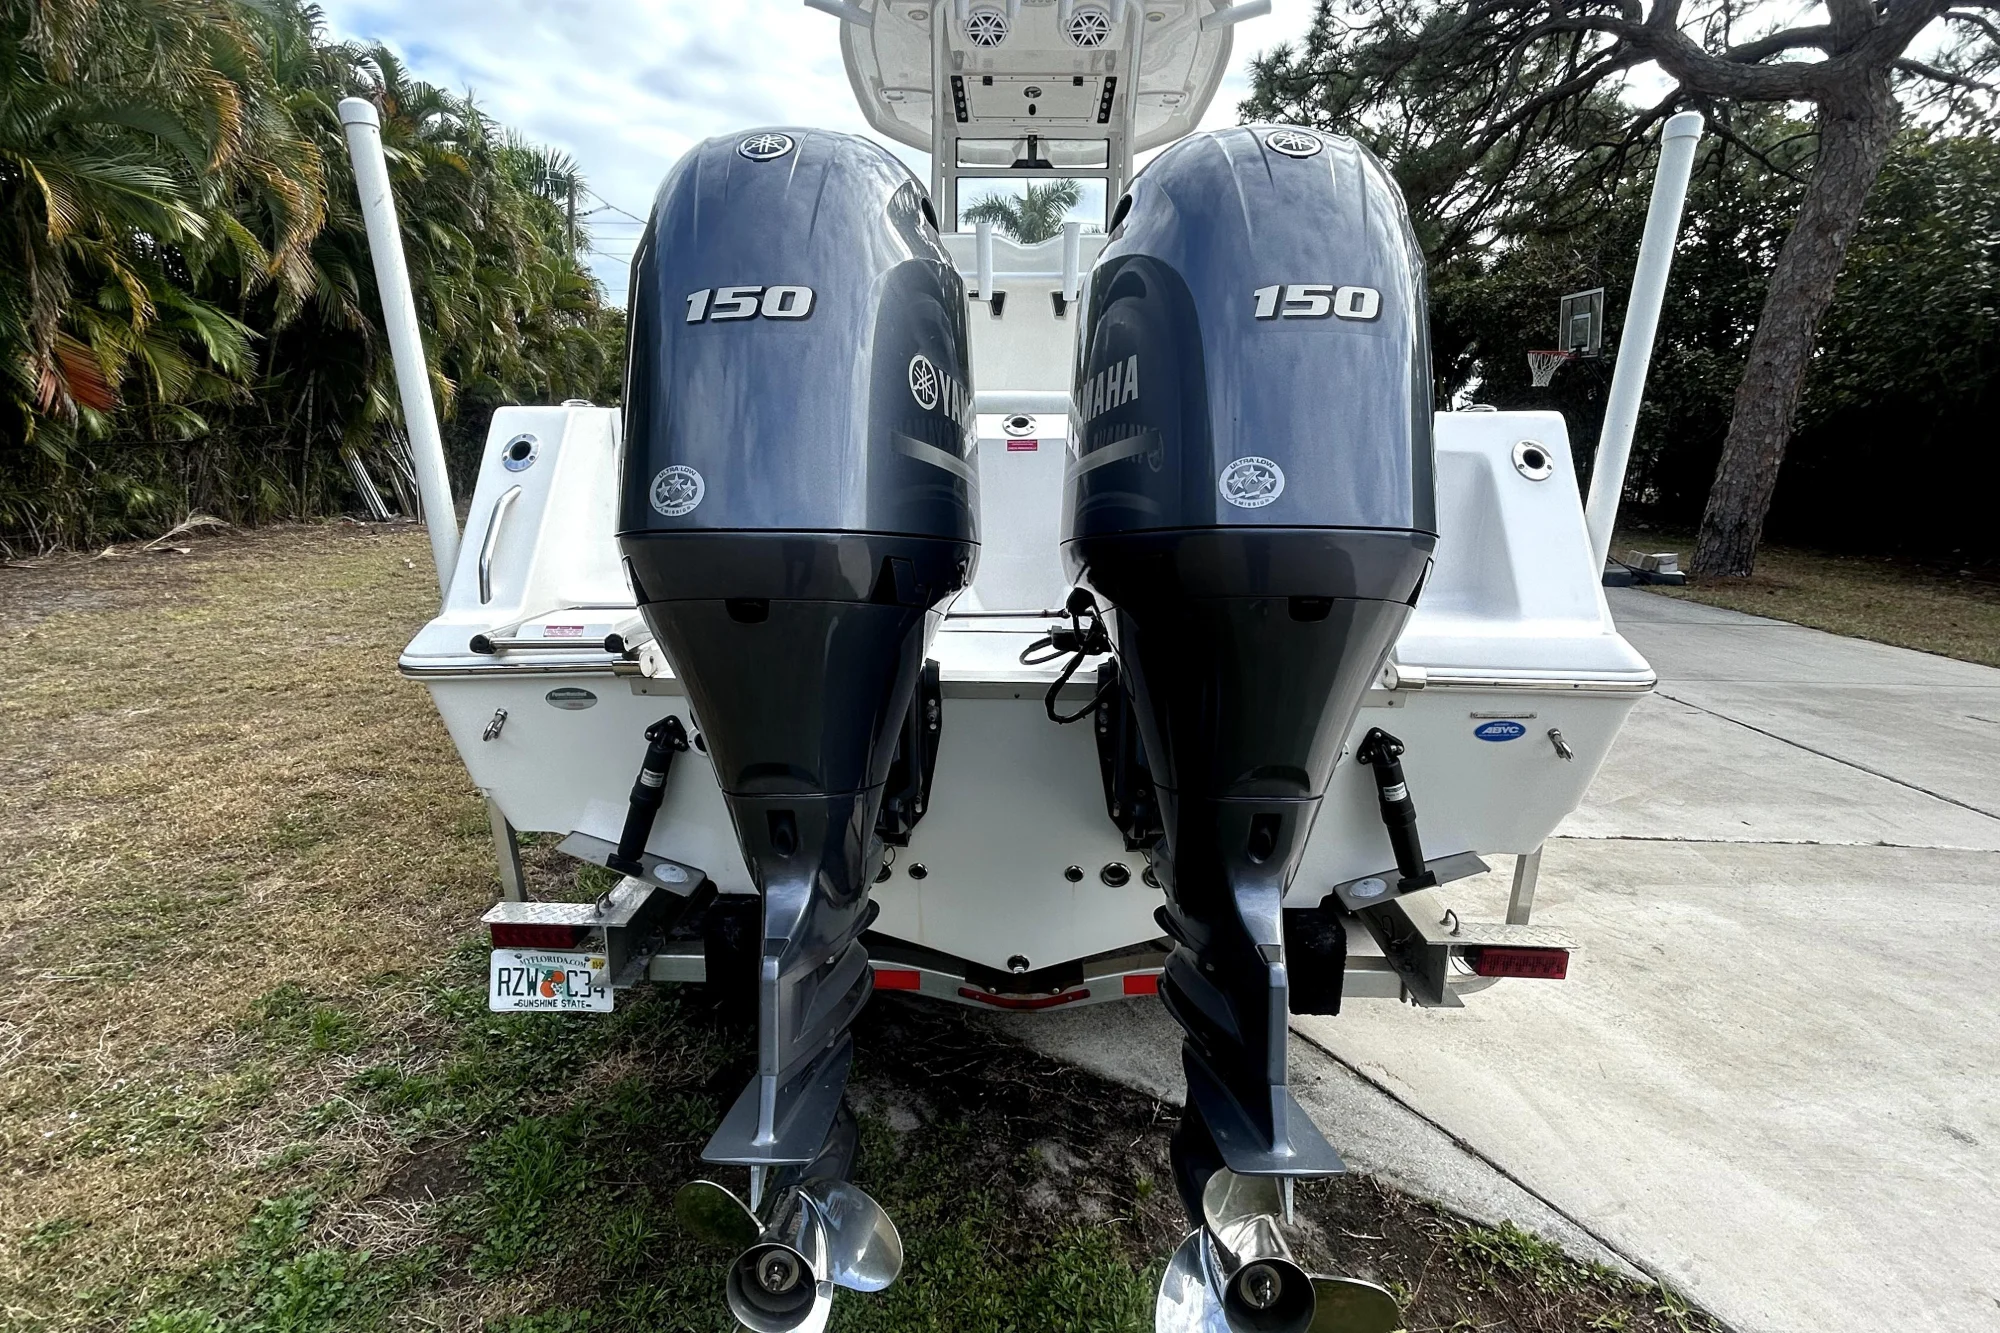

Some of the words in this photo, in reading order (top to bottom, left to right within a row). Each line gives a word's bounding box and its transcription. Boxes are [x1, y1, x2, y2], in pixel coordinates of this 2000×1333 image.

[686, 285, 815, 323] 150
[1252, 284, 1381, 320] 150
[1230, 458, 1254, 470] ULTRA
[1256, 458, 1275, 468] LOW
[658, 466, 679, 479] ULTRA
[681, 467, 697, 476] LOW
[1481, 726, 1520, 734] ABYC
[519, 955, 587, 968] MYFLORIDA.COM
[497, 967, 539, 996] RZW
[518, 999, 558, 1008] SUNSHINE
[561, 1000, 586, 1009] STATE
